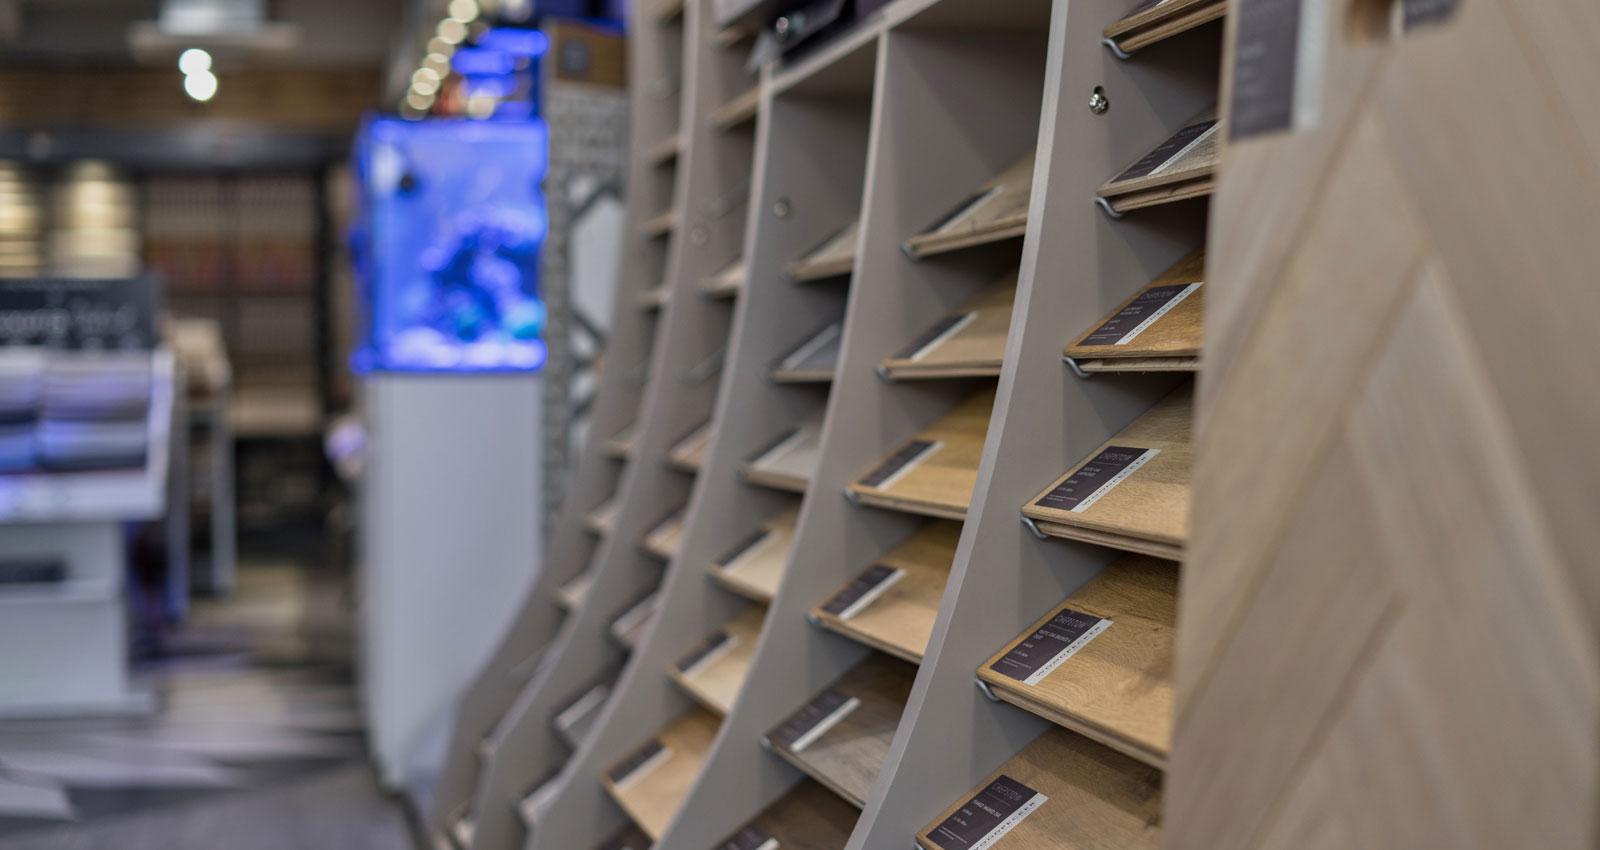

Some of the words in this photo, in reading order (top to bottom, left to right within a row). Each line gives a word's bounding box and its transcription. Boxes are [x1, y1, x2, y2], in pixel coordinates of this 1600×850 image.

[1082, 457, 1147, 506] WOODPECKER
[1036, 626, 1101, 677] WOODPECKER
[991, 782, 1025, 802] CHEPSTOW
